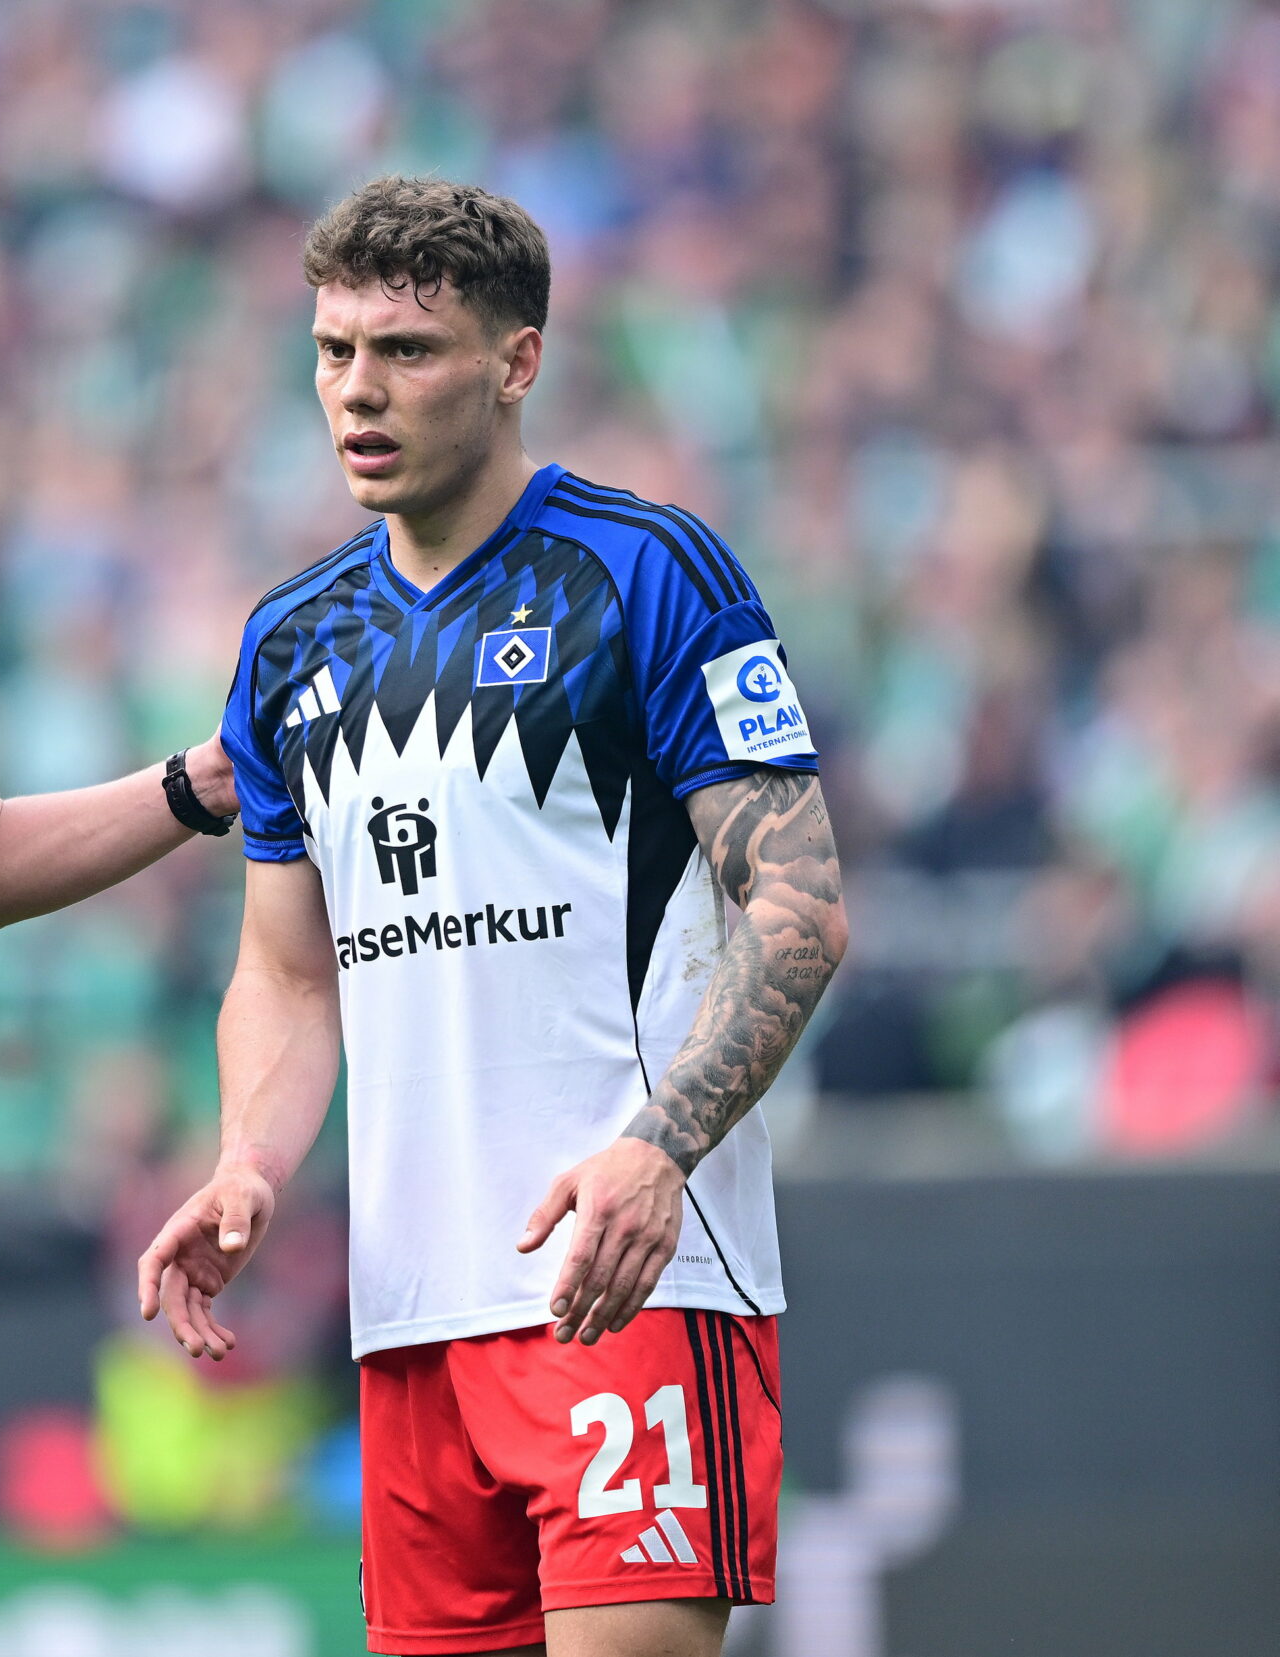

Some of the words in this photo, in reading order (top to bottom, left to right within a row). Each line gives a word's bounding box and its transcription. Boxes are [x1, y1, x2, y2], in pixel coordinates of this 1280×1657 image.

[738, 703, 803, 742] PLAN
[746, 729, 808, 754] INTERNATIONAL
[336, 902, 572, 971] aseMerkur
[570, 1384, 708, 1519] 21
